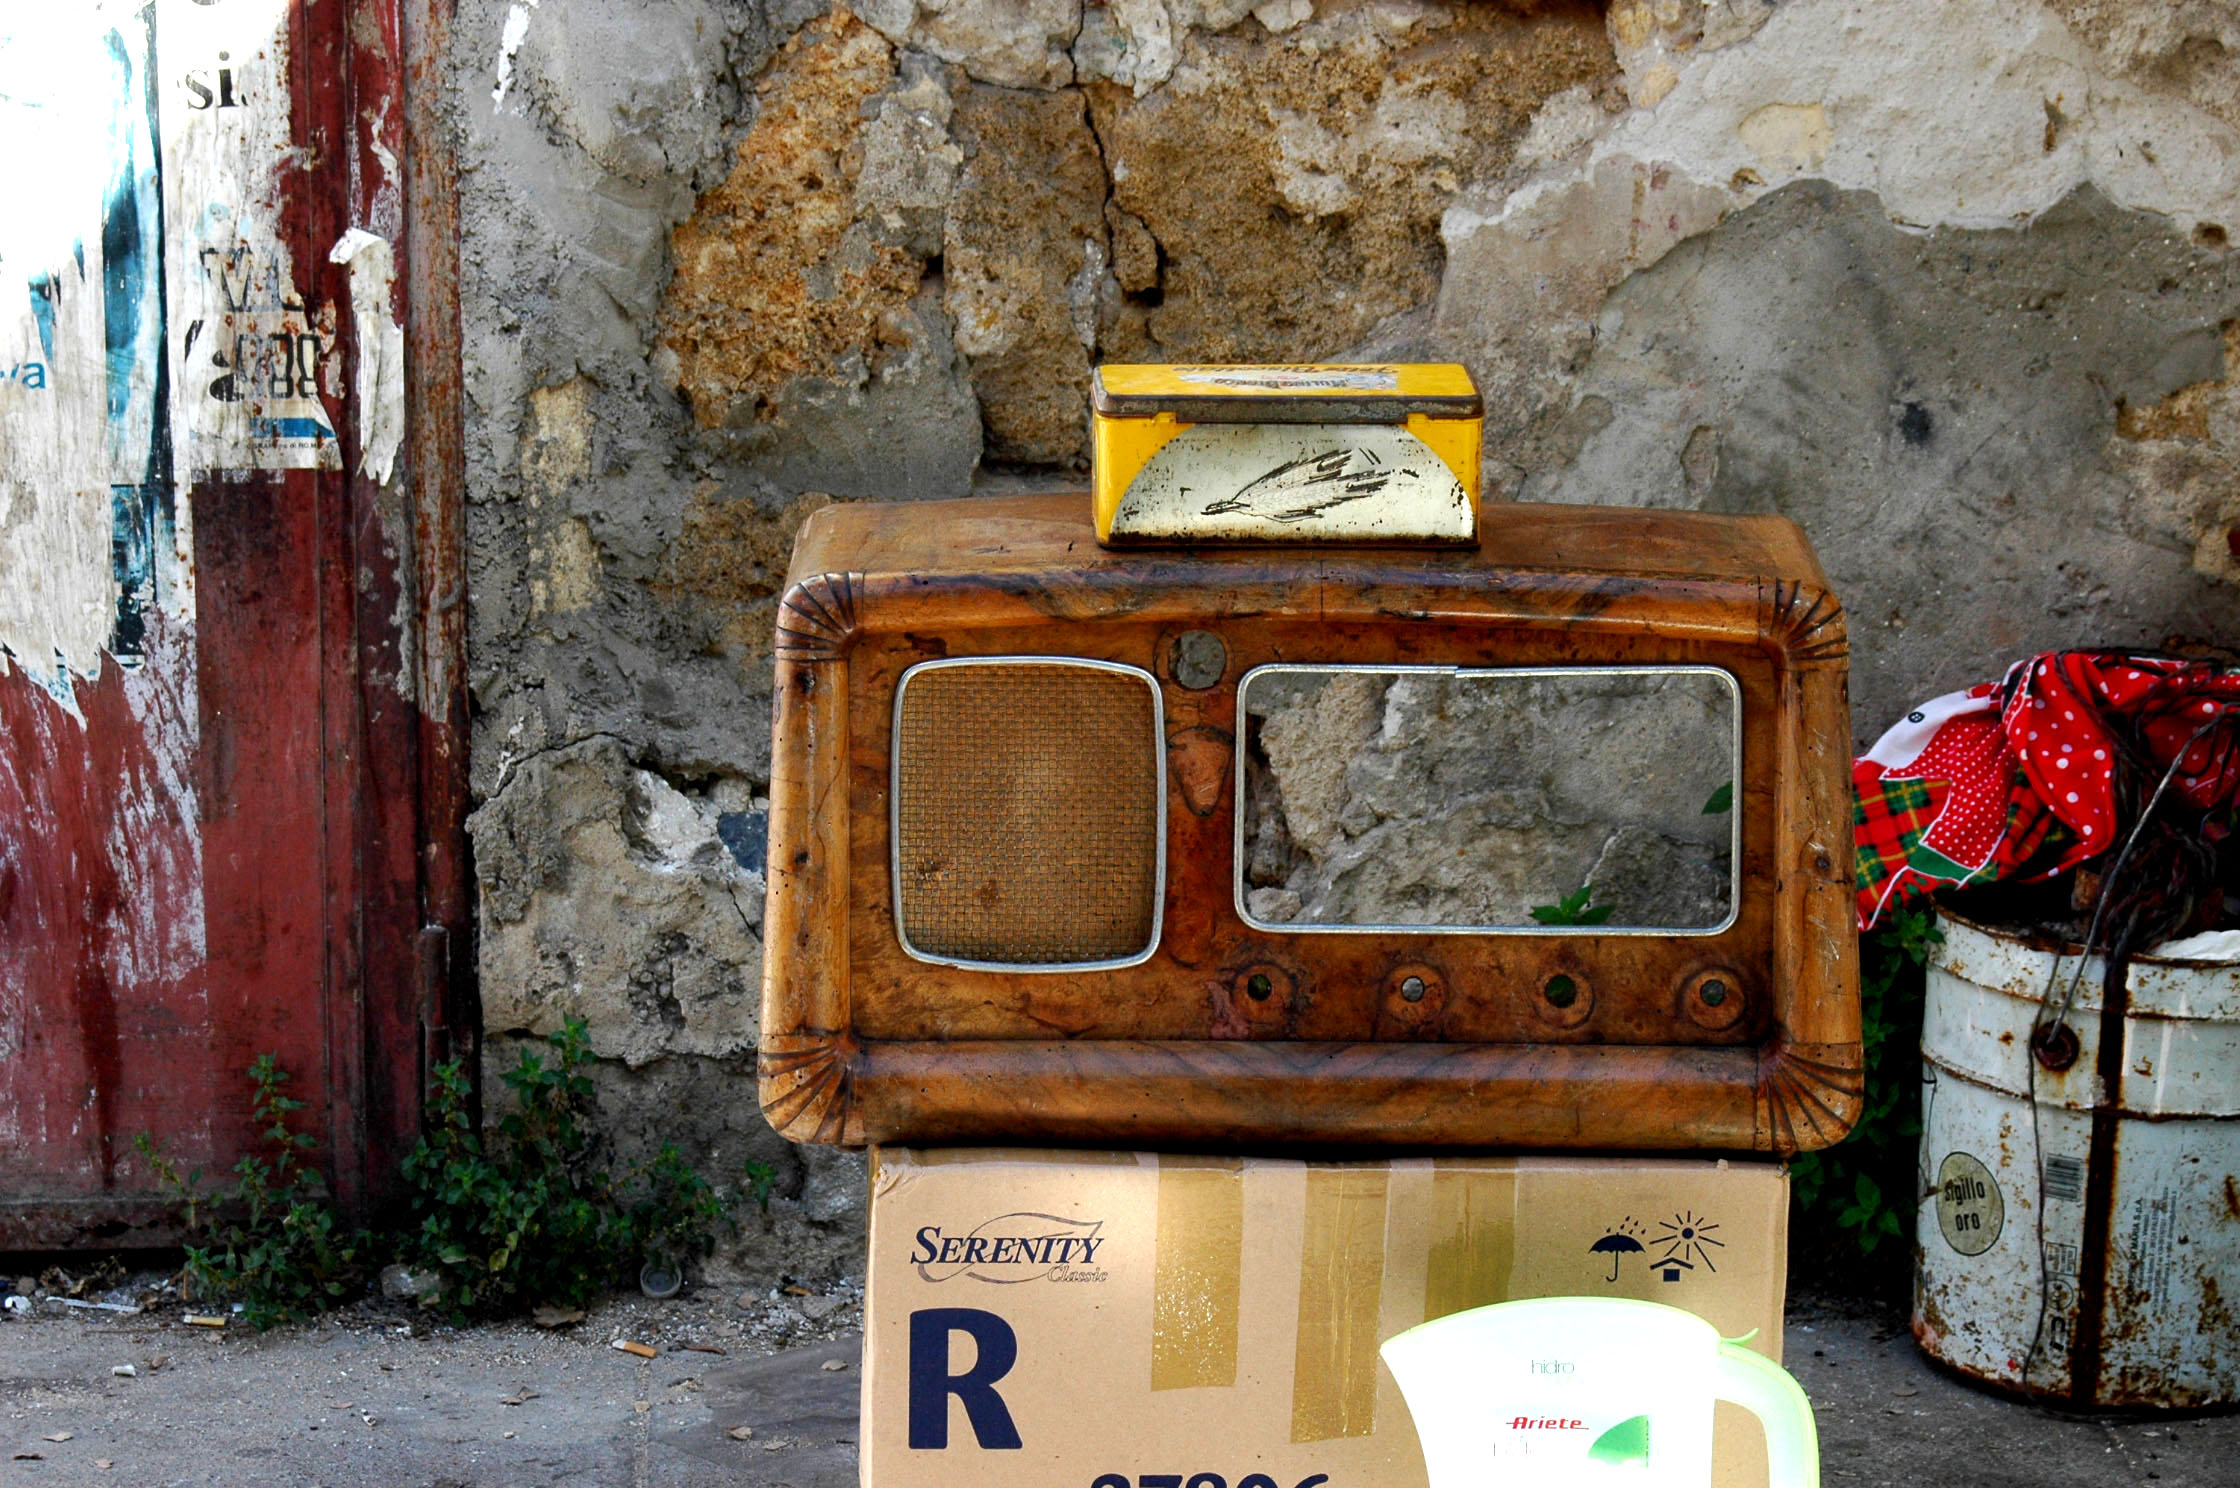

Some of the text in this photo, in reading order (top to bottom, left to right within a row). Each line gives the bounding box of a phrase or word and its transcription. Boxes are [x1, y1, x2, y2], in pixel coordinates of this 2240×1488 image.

[1944, 1177, 1985, 1206] sigillo
[1955, 1213, 1980, 1231] oro
[909, 1226, 1105, 1266] SERENITY
[1046, 1265, 1110, 1283] Classic
[908, 1307, 1023, 1450] R
[1506, 1415, 1589, 1430] Ariete
